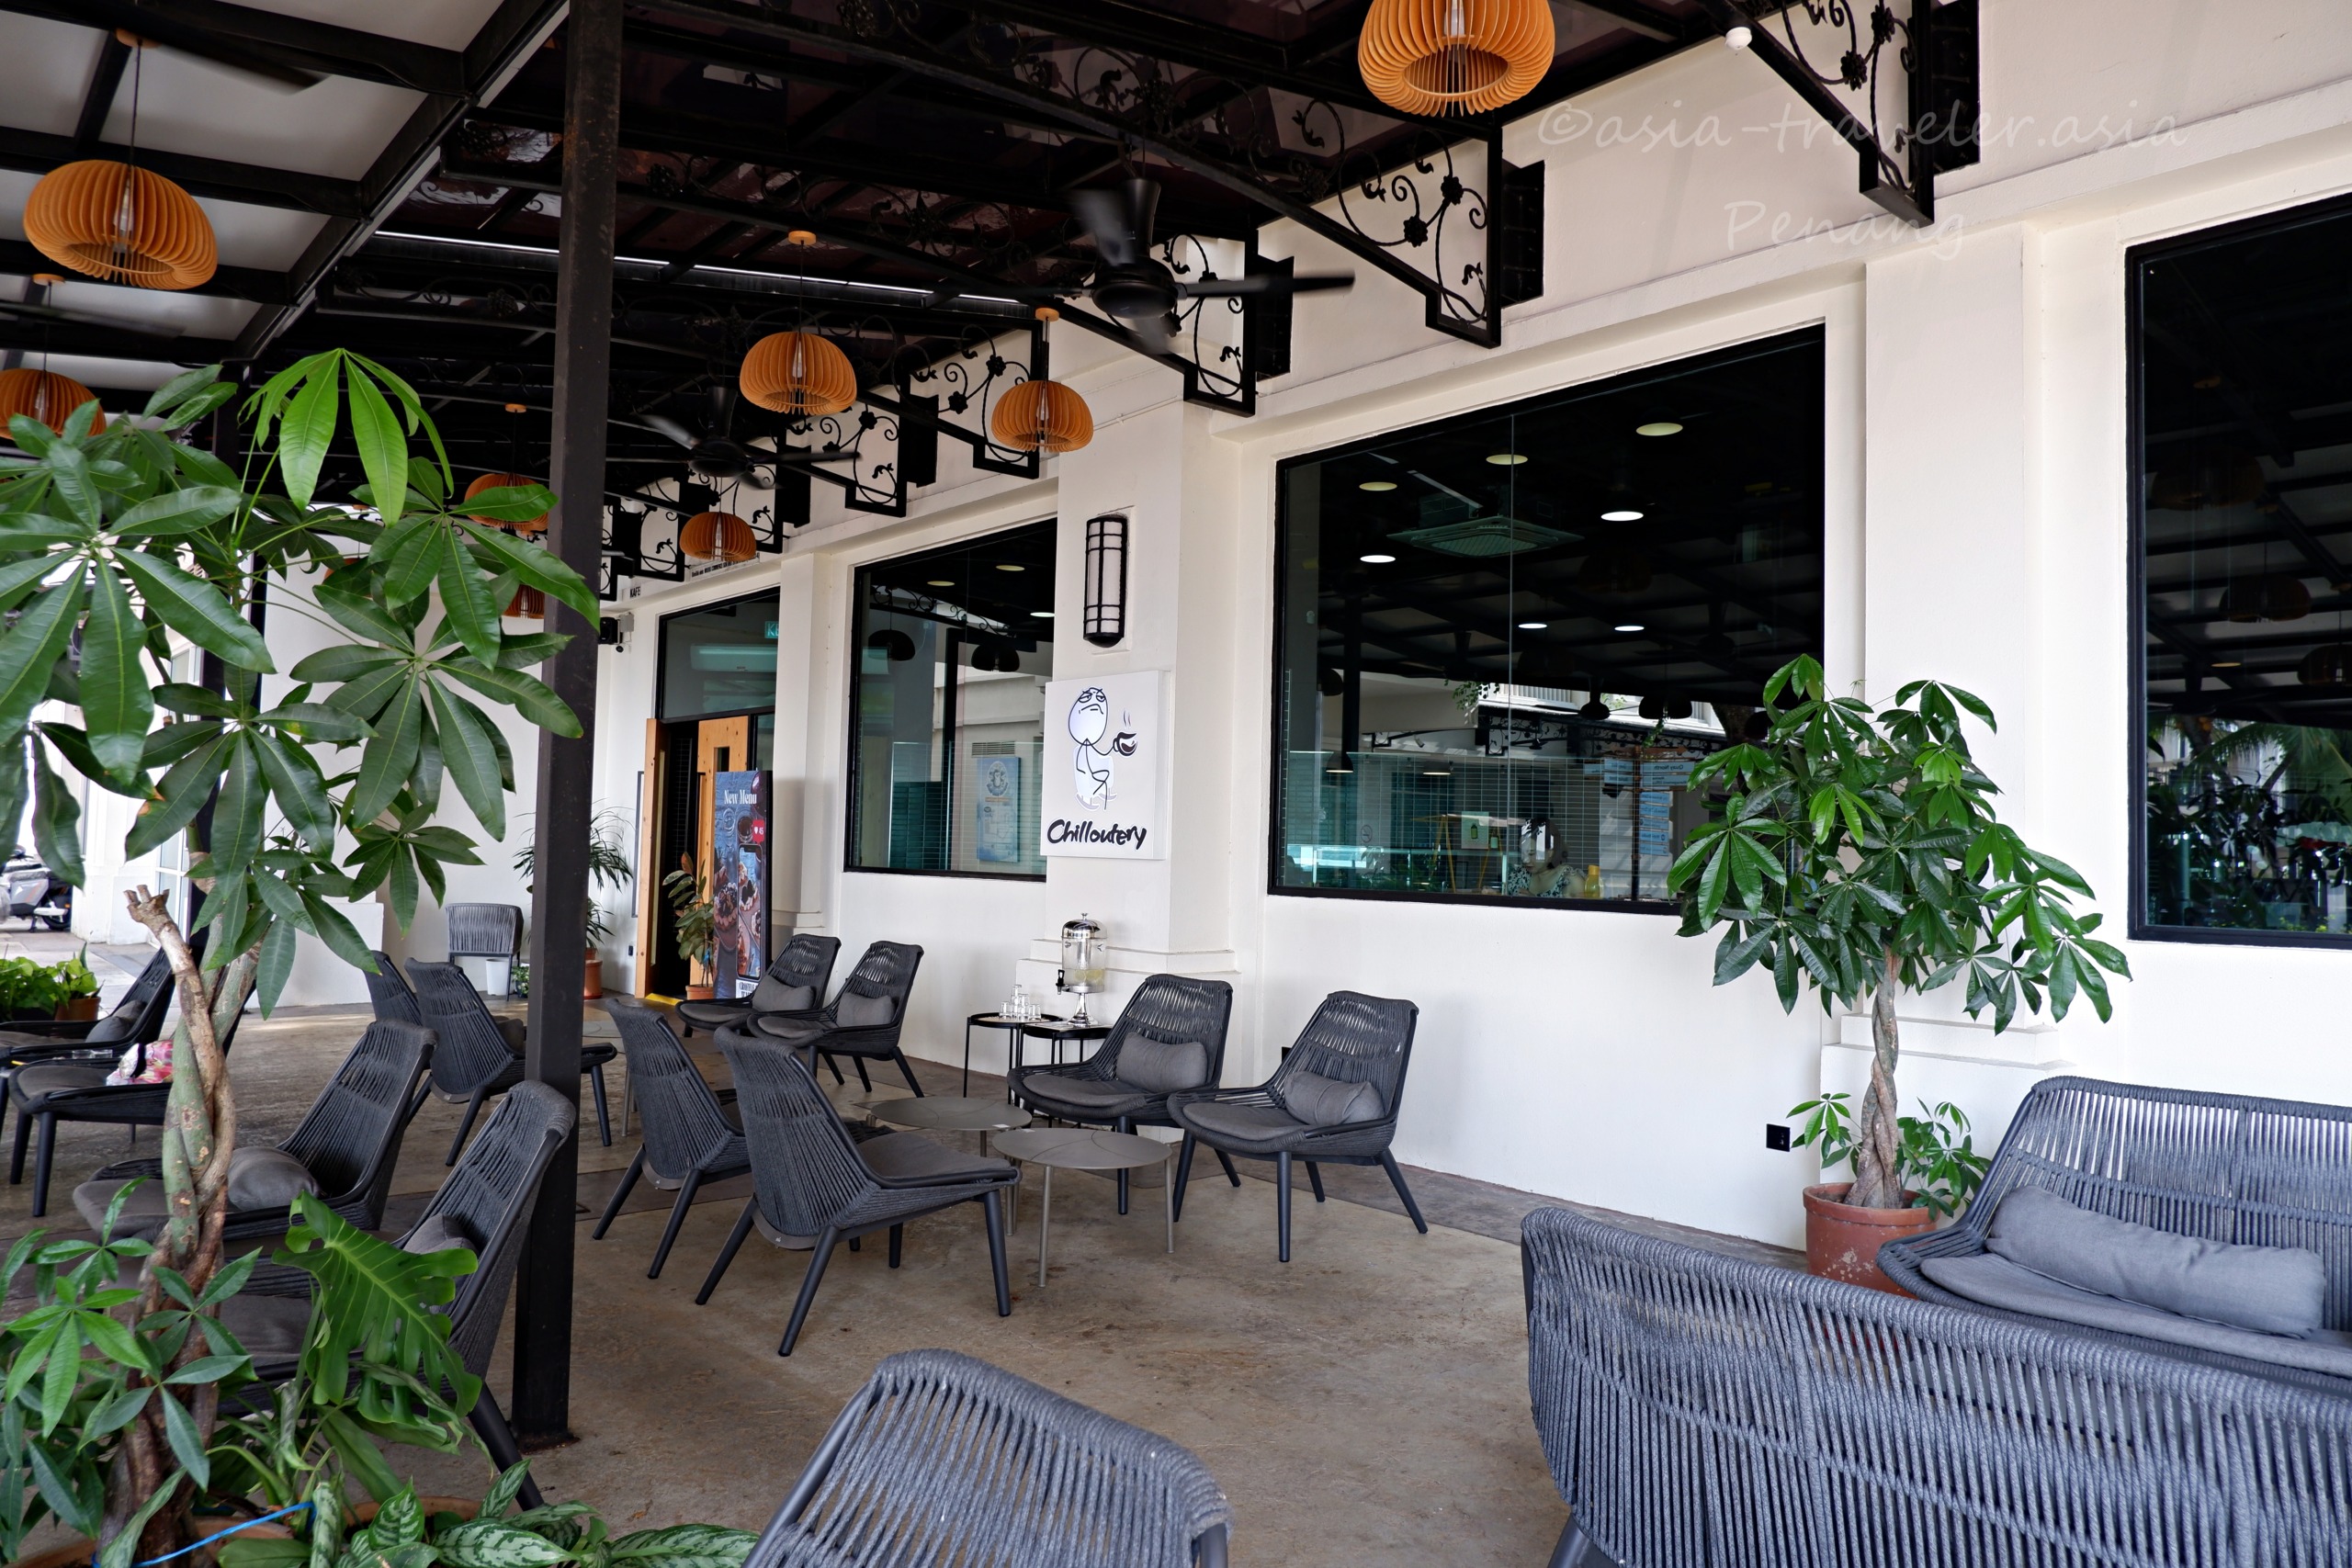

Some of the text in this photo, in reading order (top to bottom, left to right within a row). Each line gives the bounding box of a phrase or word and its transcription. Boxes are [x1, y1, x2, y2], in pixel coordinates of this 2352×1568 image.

[630, 586, 640, 598] KAFE
[724, 789, 757, 805] New Menu
[1047, 819, 1148, 850] Chilloutery
